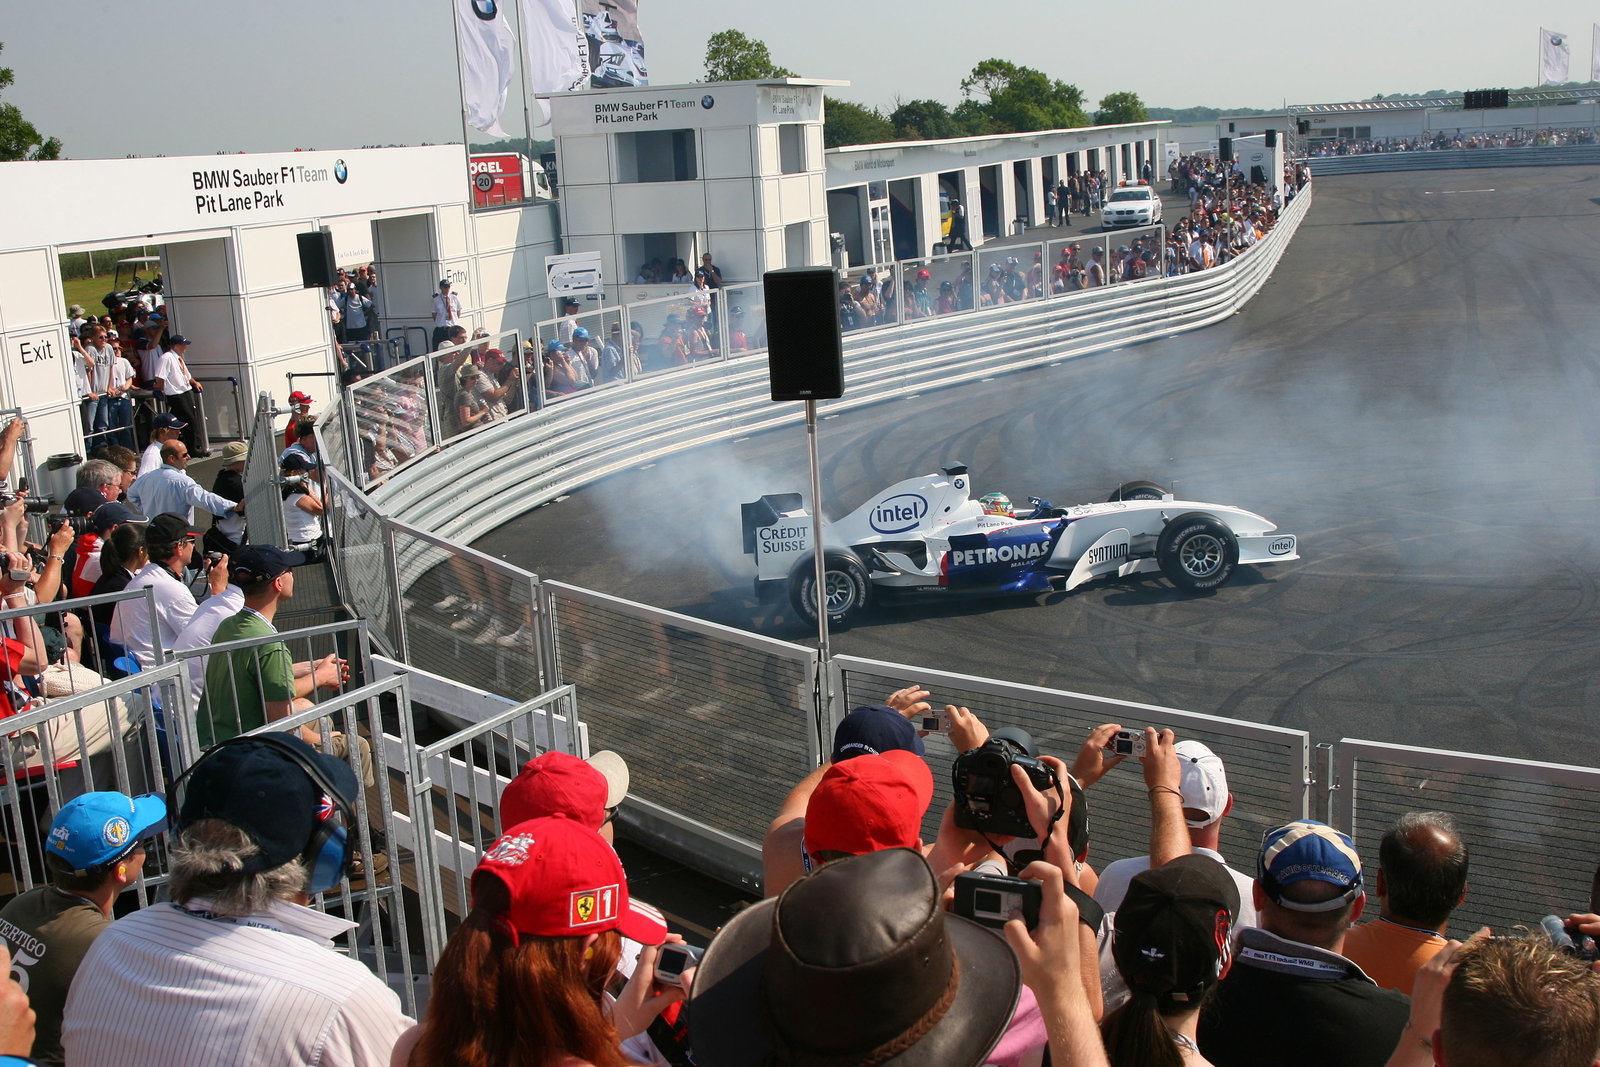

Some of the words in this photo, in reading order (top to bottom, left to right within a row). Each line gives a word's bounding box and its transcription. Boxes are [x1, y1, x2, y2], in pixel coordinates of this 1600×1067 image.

[578, 44, 588, 57] F1
[595, 103, 620, 113] BMW
[621, 101, 655, 112] Sauber
[657, 100, 669, 109] F1
[669, 99, 695, 109] Team
[595, 114, 609, 124] Pit
[610, 113, 634, 123] Lane
[636, 112, 658, 121] Park
[193, 170, 230, 190] BMW
[233, 168, 279, 187] Sauber
[281, 167, 296, 183] F1
[297, 166, 328, 182] Team
[479, 177, 490, 187] 20
[196, 195, 216, 214] Pit
[219, 194, 252, 212] Lane
[254, 190, 284, 208] Park
[447, 269, 468, 285] Entry
[20, 340, 53, 364] Exit
[877, 502, 919, 522] intel
[763, 540, 806, 553] SUISSE
[953, 541, 1050, 566] PETRONAS
[1089, 543, 1128, 564] SYNTIUM
[1272, 541, 1291, 550] intel
[603, 889, 612, 918] 1
